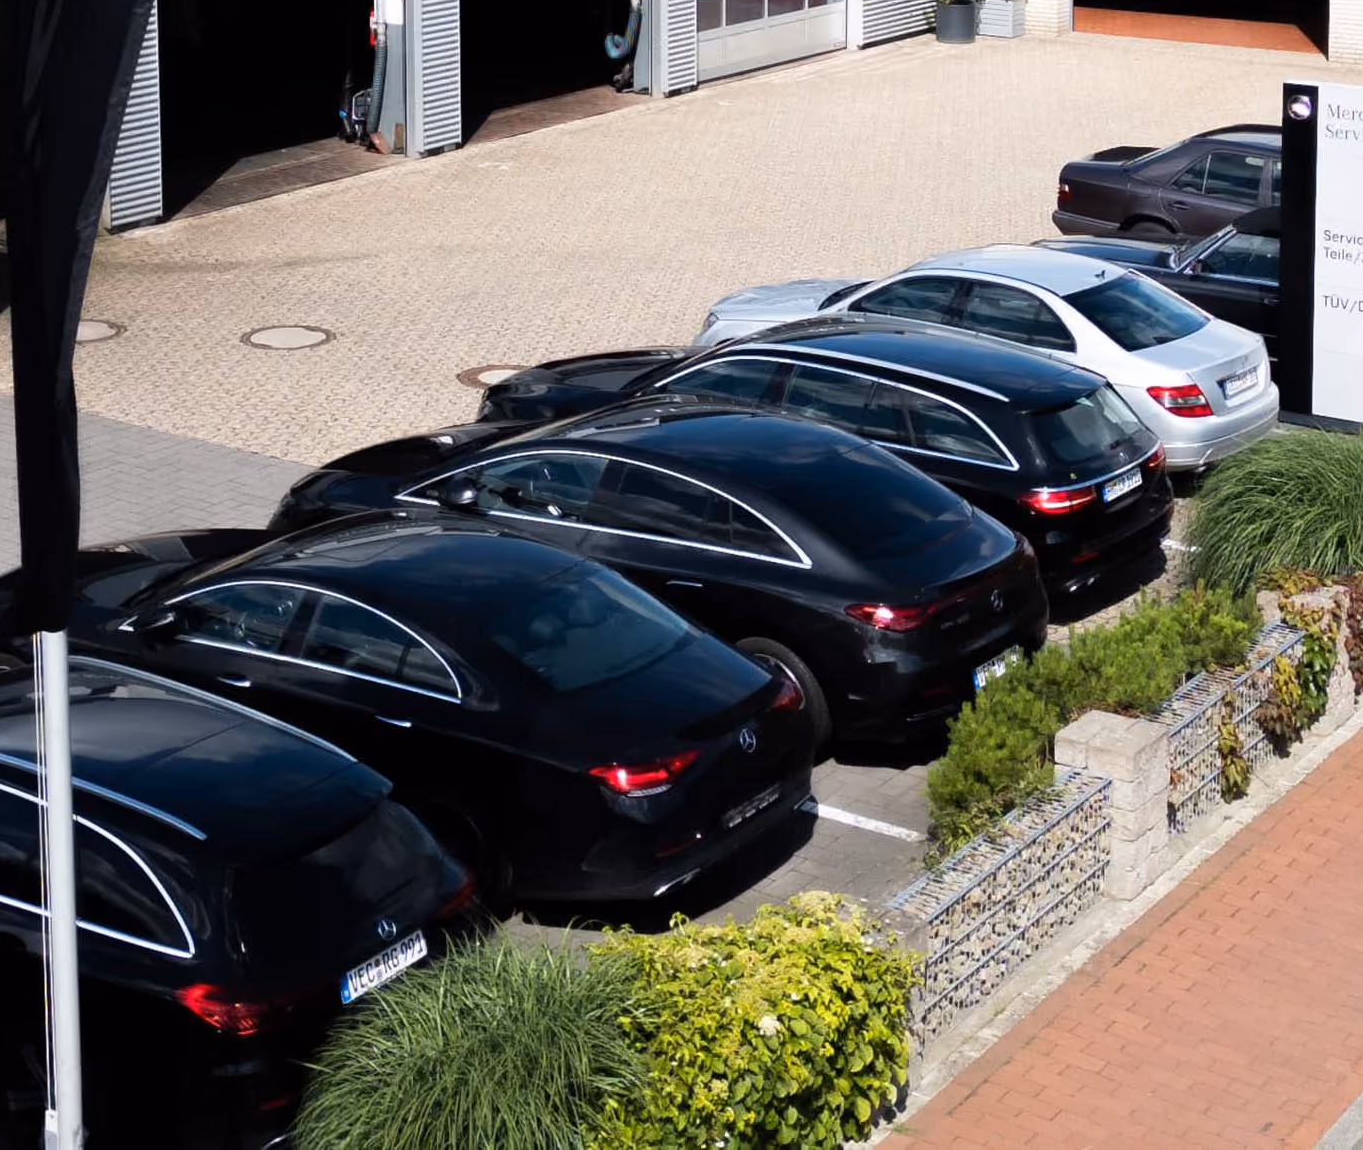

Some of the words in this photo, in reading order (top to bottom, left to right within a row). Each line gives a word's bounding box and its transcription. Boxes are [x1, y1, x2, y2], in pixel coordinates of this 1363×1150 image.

[349, 962, 376, 992] VEC
[381, 948, 400, 974] RG
[400, 932, 424, 963] 991
